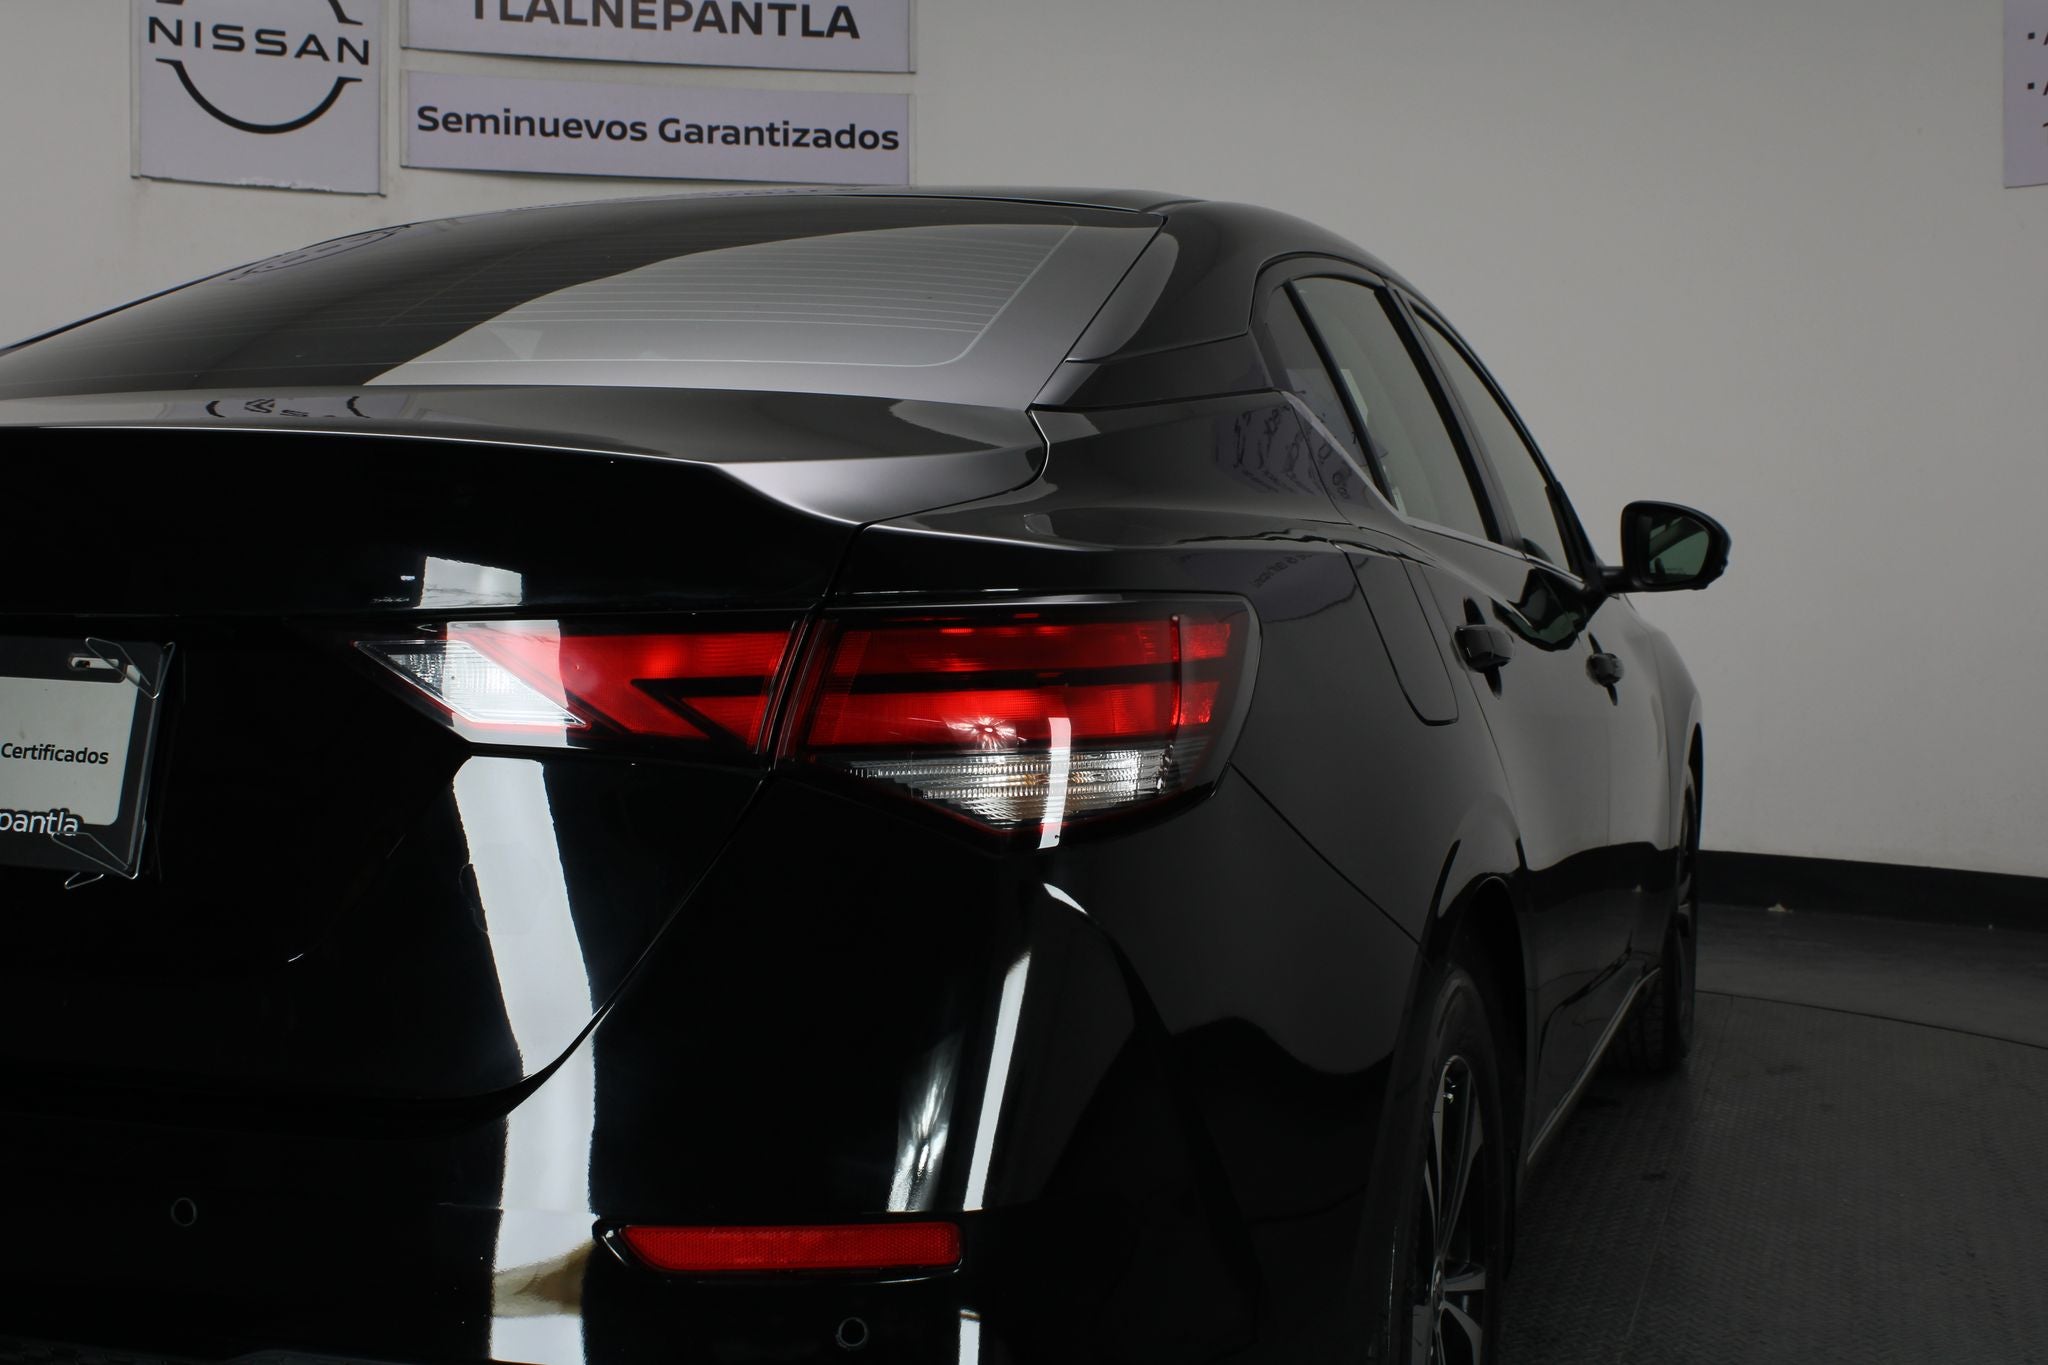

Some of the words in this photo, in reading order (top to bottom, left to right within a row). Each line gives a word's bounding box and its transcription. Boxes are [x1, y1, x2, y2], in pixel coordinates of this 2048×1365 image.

[149, 16, 369, 65] NISSAN
[417, 105, 648, 141] Seminuevos
[658, 117, 900, 151] Garantizados
[1, 742, 109, 765] Certificados
